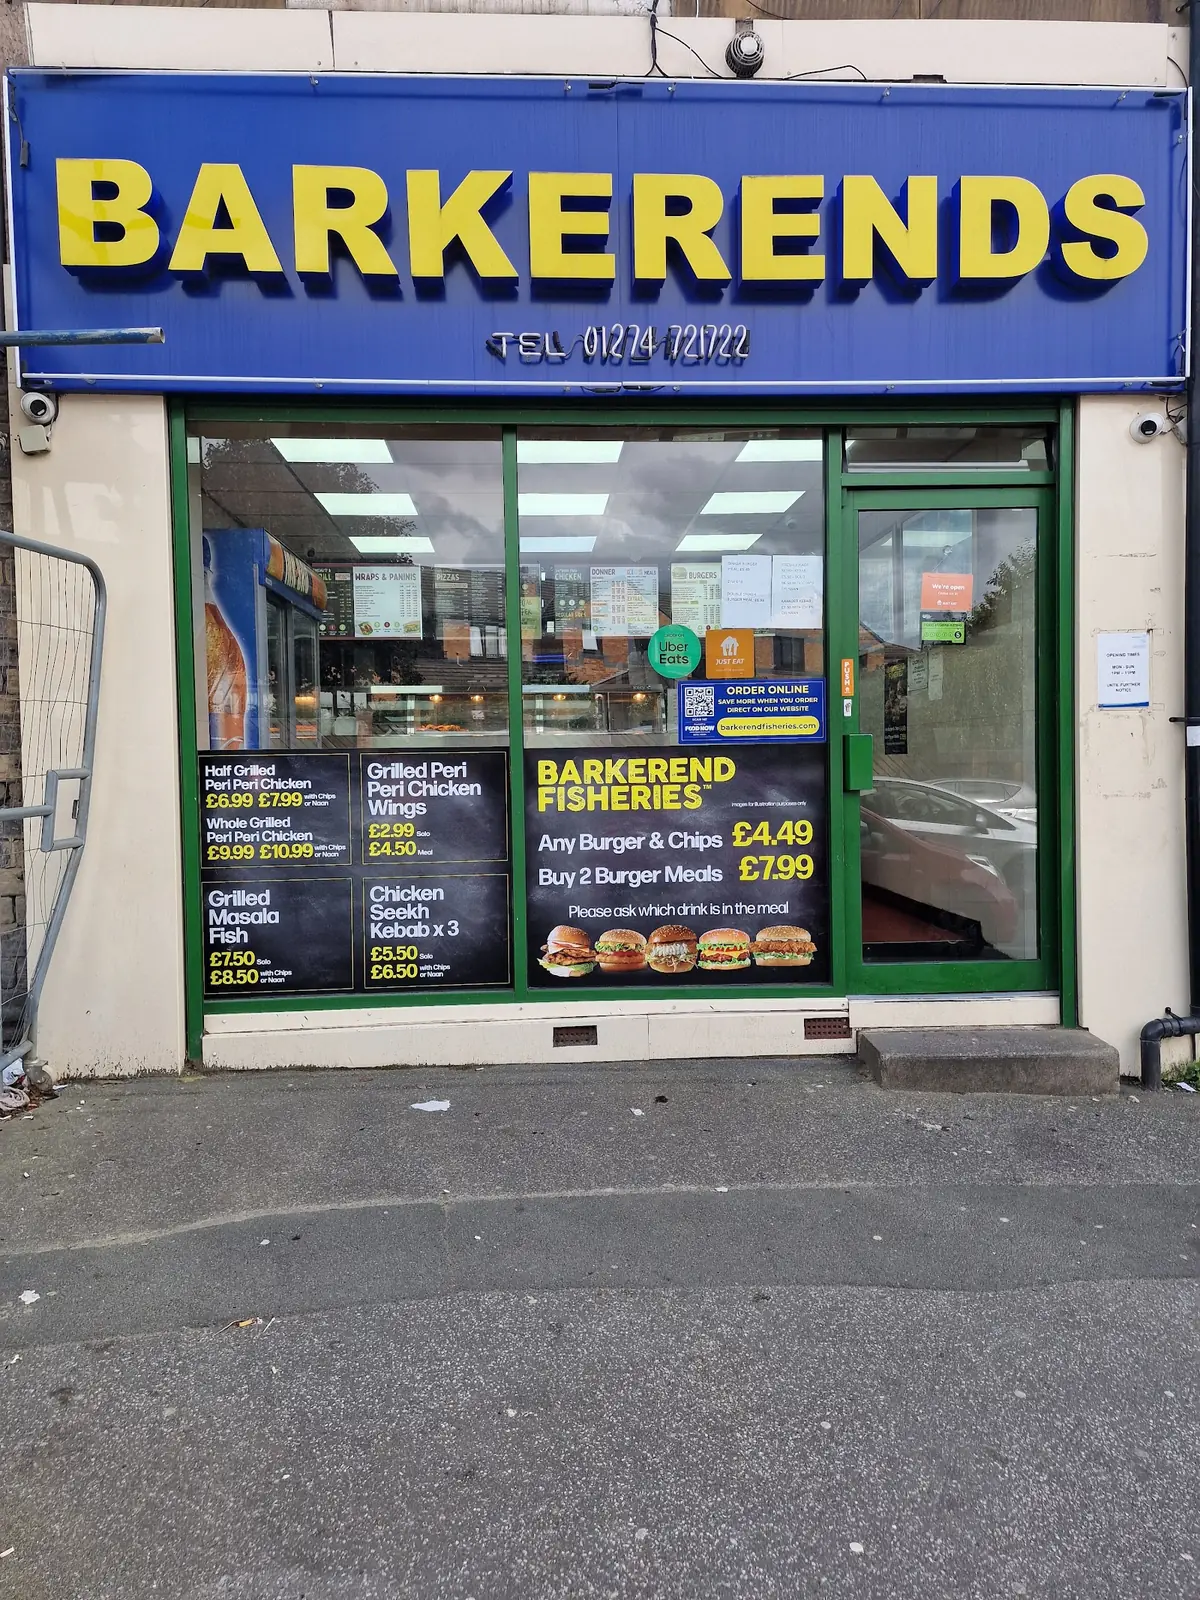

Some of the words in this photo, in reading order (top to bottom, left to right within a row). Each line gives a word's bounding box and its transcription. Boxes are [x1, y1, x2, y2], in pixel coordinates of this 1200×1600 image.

[55, 158, 1149, 281] BARKERENDS
[492, 332, 566, 358] TEL
[584, 324, 657, 358] 01274
[670, 324, 749, 360] 721722
[389, 573, 417, 581] PANINIS
[555, 572, 581, 580] CHICKEN
[660, 641, 688, 652] Uber
[660, 654, 689, 664] Eats
[726, 686, 765, 695] ORDER
[768, 685, 809, 694] ONLINE
[720, 722, 816, 730] barkerendfisheries.com
[205, 765, 232, 777] Half
[234, 764, 275, 776] Grilled
[367, 762, 427, 779] Grilled
[431, 762, 467, 778] Peri
[537, 757, 736, 785] BARKEREND
[205, 779, 230, 791] Peri
[233, 778, 258, 790] Peri
[260, 778, 312, 790] Chicken
[368, 782, 405, 798] Peri
[407, 781, 481, 797] Chicken
[206, 792, 253, 809] £6.99
[258, 791, 302, 807] £7.99
[318, 793, 336, 801] Chips
[368, 800, 427, 819] Wings
[207, 817, 247, 829] Whole
[249, 816, 290, 828] Grilled
[207, 831, 232, 843] Peri
[234, 830, 259, 842] Peri
[261, 830, 313, 842] Chicken
[368, 823, 414, 839] £2.99
[538, 834, 576, 854] Any
[579, 833, 646, 854] Burger
[649, 832, 665, 848] &
[668, 831, 723, 852] Chips
[732, 820, 813, 847] £4.49
[207, 844, 254, 861] £9.99
[259, 844, 313, 860] £10.99
[329, 844, 346, 852] Chips
[369, 841, 416, 857] £4.50
[538, 869, 576, 888] Buy
[579, 868, 592, 884] 2
[595, 867, 661, 888] Burger
[665, 865, 723, 882] Meals
[739, 855, 814, 882] £7.99
[208, 890, 270, 907] Grilled
[369, 885, 444, 902] Chicken
[209, 908, 280, 925] Masala
[370, 903, 429, 921] Seekh
[568, 905, 612, 918] Please
[613, 904, 636, 917] ask
[638, 904, 675, 917] which
[677, 903, 708, 916] drink
[710, 903, 720, 915] is
[722, 902, 733, 915] in
[734, 902, 755, 914] the
[757, 901, 789, 914] meal
[209, 928, 248, 944] Fish
[370, 922, 430, 939] Kebab
[433, 924, 445, 937] x
[447, 920, 459, 937] 3
[210, 951, 256, 967] £7.50
[370, 945, 418, 962] £5.50
[275, 969, 292, 977] Chips
[370, 963, 418, 980] £6.50
[434, 964, 450, 972] Chips
[210, 969, 259, 985] £8.50
